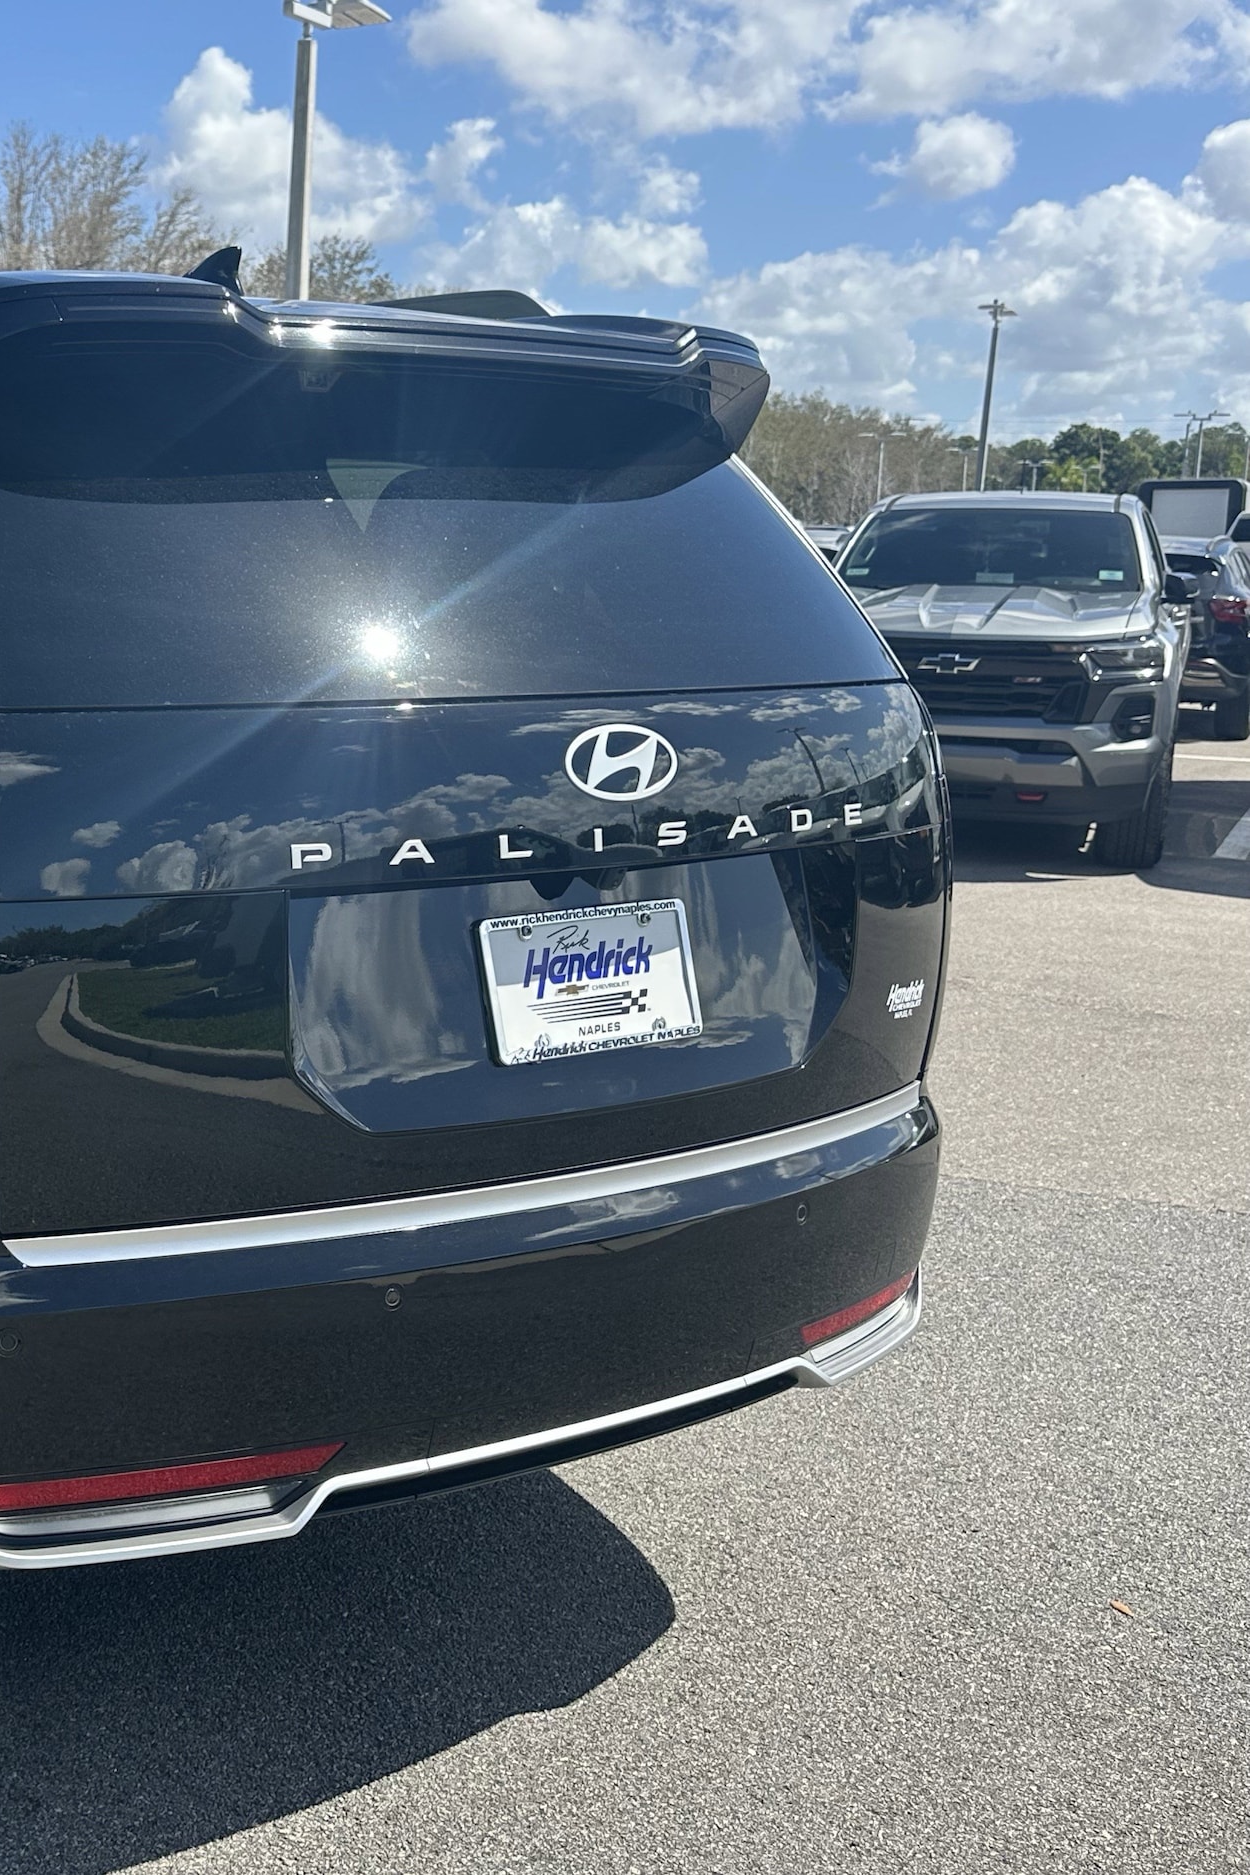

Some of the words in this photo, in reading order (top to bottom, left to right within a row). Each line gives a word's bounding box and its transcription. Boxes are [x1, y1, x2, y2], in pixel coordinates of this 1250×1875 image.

[290, 803, 864, 870] PALISADE
[490, 900, 676, 929] www.rickhendrickchevynaples.com
[523, 936, 652, 999] Hendrick
[592, 981, 630, 991] CHEVROLET
[532, 1040, 587, 1060] Hendrick
[588, 1032, 655, 1052] CHEVROLET
[657, 1025, 701, 1039] NAPLES
[578, 1021, 622, 1037] NAPLES
